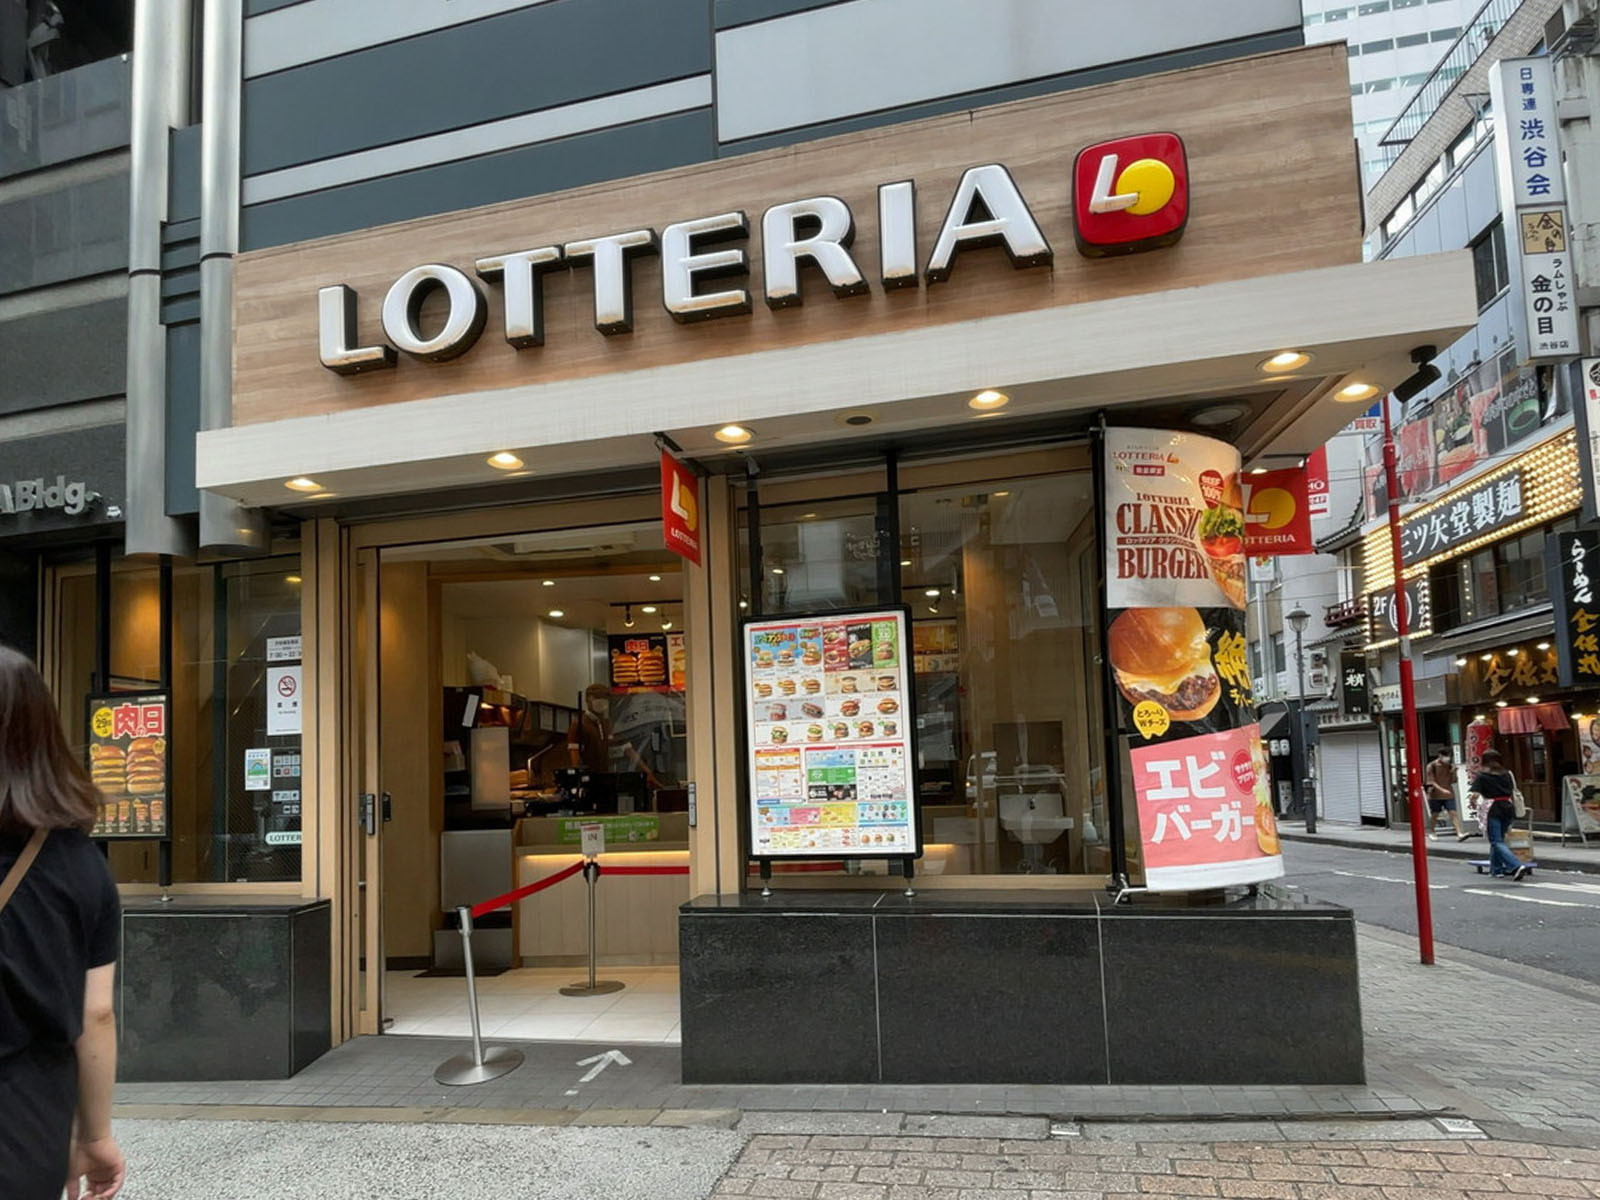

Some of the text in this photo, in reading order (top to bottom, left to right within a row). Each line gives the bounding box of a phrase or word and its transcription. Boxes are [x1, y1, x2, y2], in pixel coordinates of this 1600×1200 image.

[318, 163, 1052, 374] LOTTERIA
[1552, 258, 1568, 312] ラムしゃぶ
[1531, 274, 1553, 335] 金の目
[1136, 492, 1190, 506] LOTTERIA
[1399, 475, 1522, 559] 三ツ矢堂製麺
[1117, 547, 1209, 580] BURGER
[1571, 538, 1594, 604] らーめん
[1373, 596, 1387, 617] 2F
[1145, 750, 1227, 801] エビ
[1150, 800, 1255, 844] バーガー
